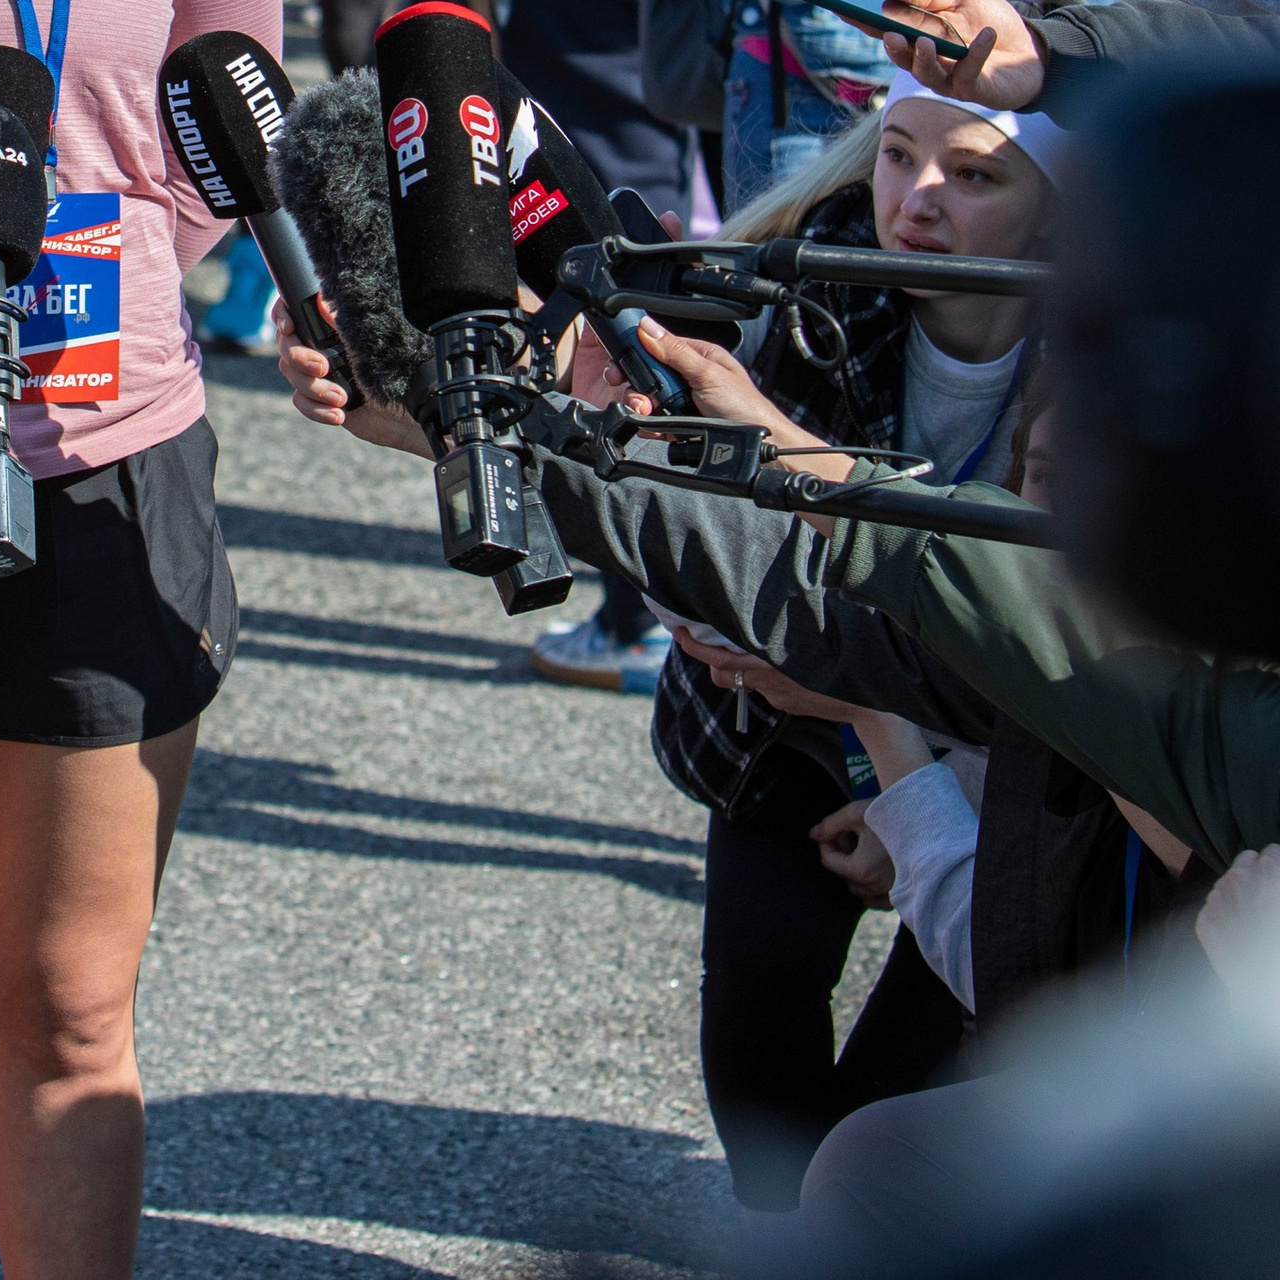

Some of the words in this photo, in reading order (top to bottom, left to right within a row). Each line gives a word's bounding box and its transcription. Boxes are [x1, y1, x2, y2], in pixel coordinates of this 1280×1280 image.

[166, 79, 217, 175] СПОРТЕ
[225, 53, 266, 96] НА
[246, 87, 286, 152] СПО
[467, 104, 501, 186] ТВЦ
[201, 175, 237, 208] НА
[392, 101, 428, 197] ТВЦ
[46, 284, 92, 314] БЕГ
